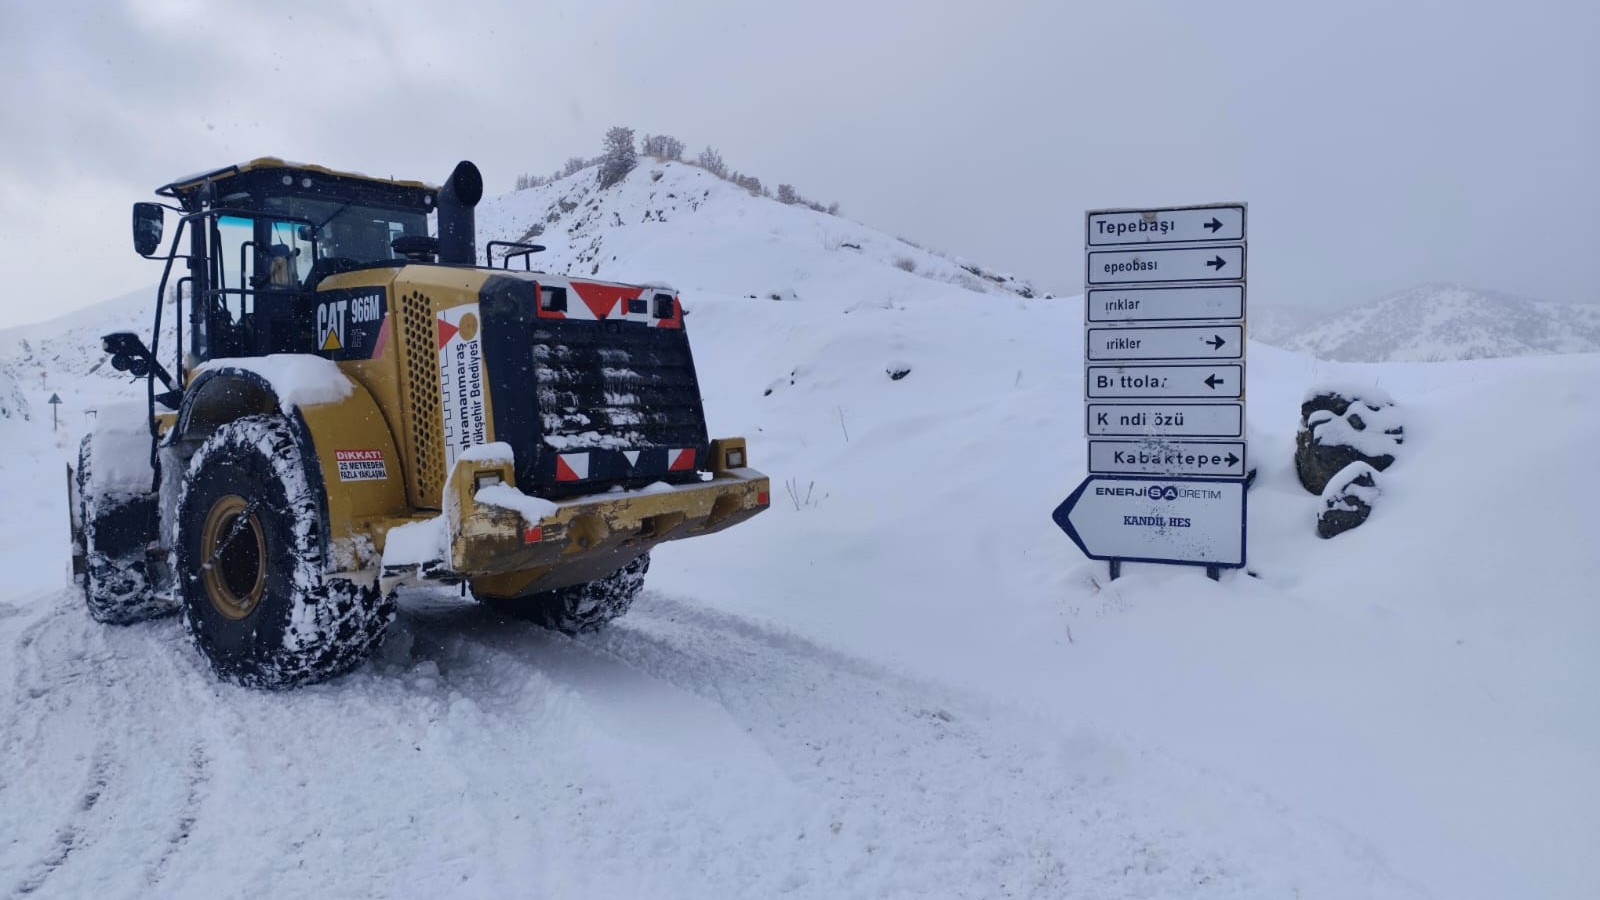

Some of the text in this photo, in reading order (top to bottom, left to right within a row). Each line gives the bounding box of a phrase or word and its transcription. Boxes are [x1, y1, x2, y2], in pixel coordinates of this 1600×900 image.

[1096, 219, 1175, 236] Tepebaşı
[1104, 259, 1158, 275] epeobası
[351, 294, 380, 324] 966M
[317, 300, 348, 351] CAT
[467, 340, 481, 398] Belediyesi
[456, 343, 471, 451] ahramanmaraş
[339, 461, 385, 470] 25 METREDEN
[1114, 451, 1221, 468] Kabaktepe
[340, 470, 358, 479] FAZLA
[1169, 517, 1191, 528] HES
